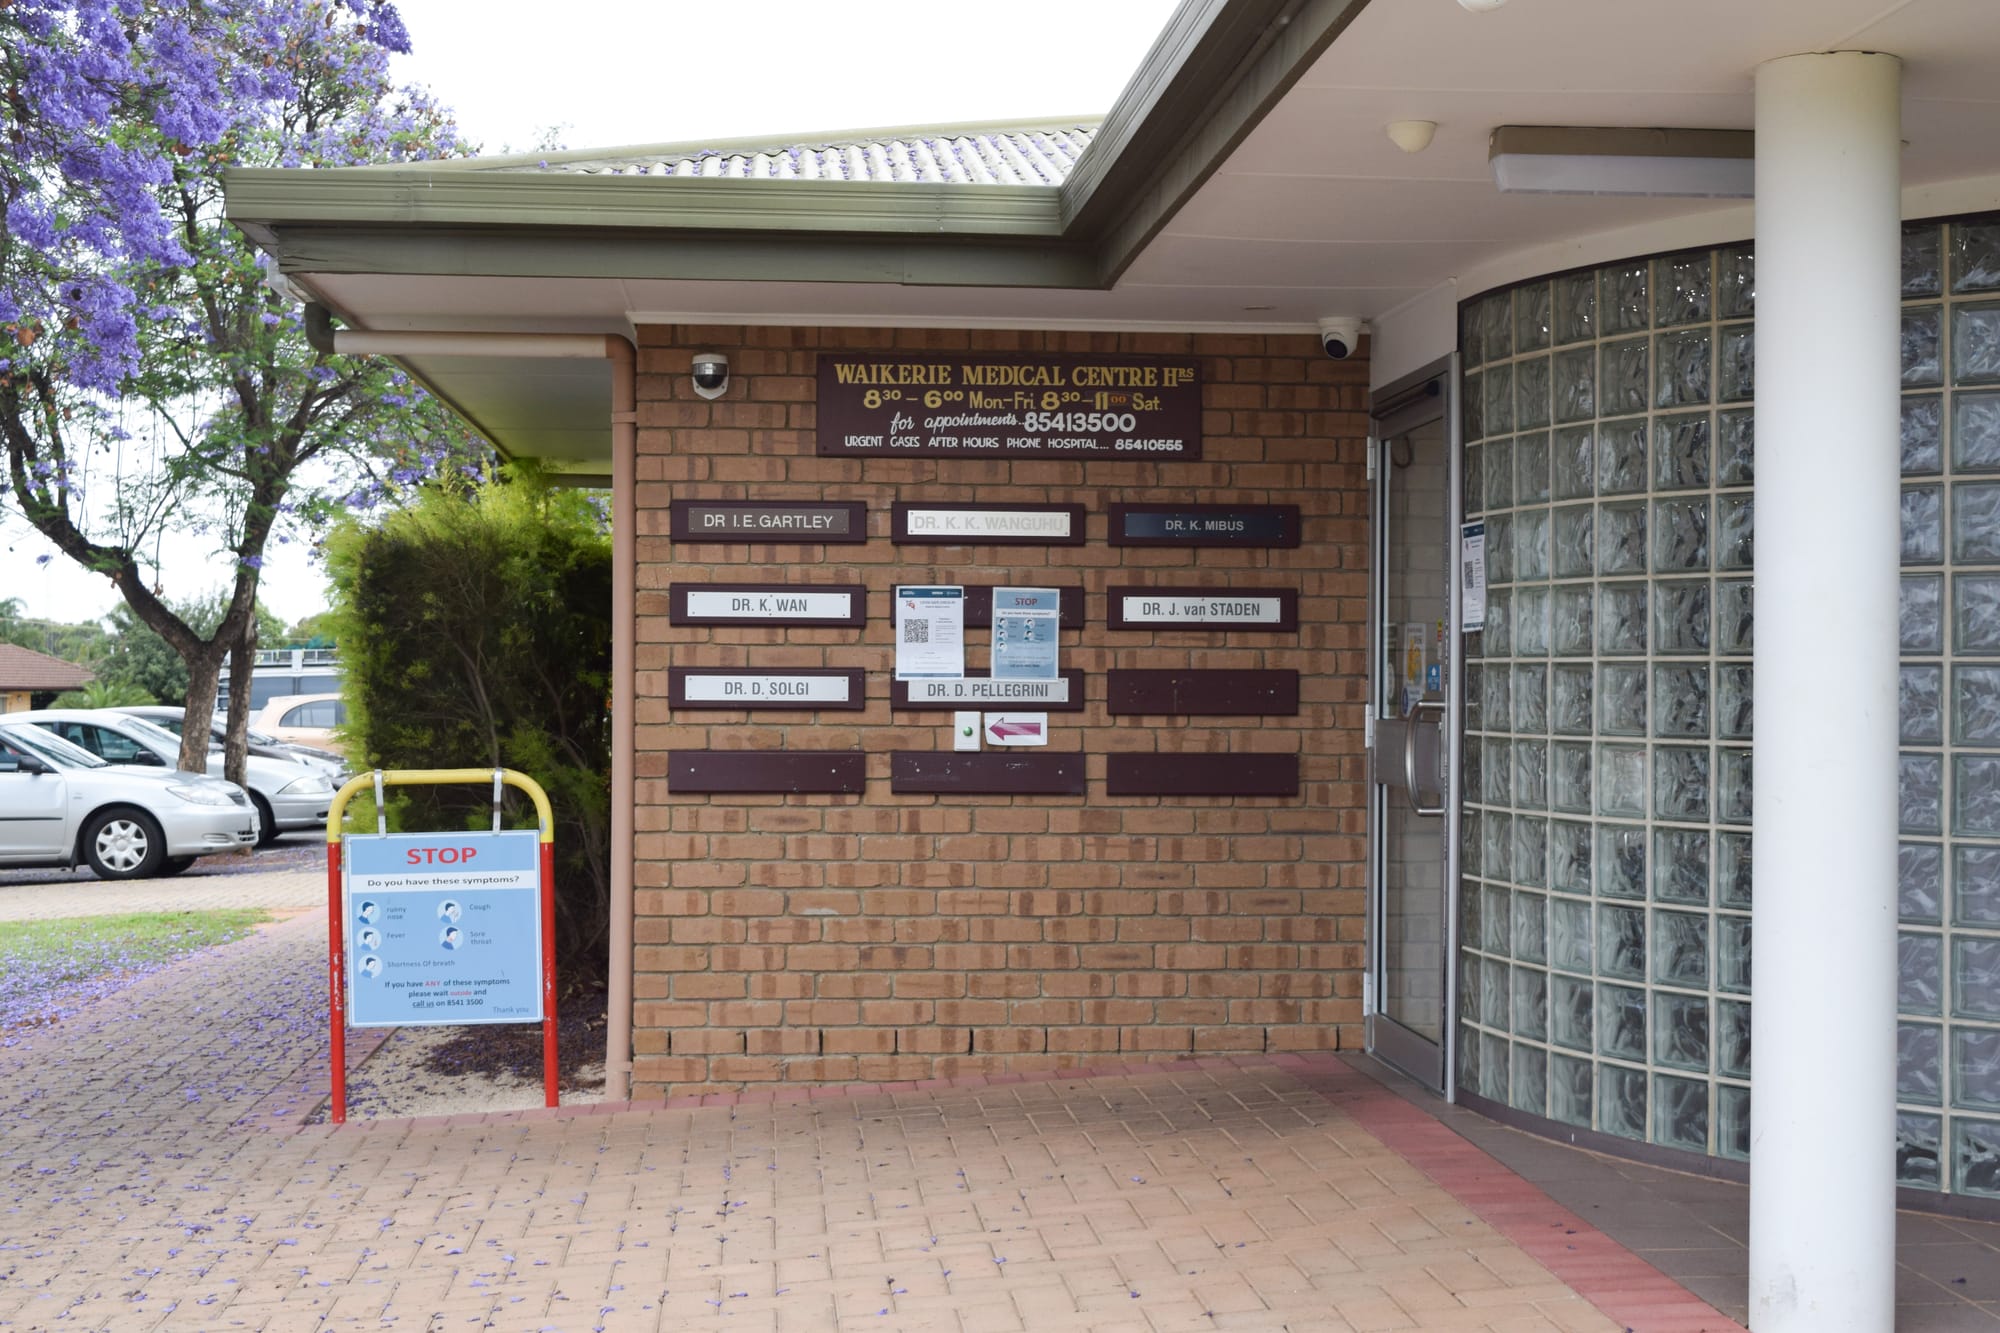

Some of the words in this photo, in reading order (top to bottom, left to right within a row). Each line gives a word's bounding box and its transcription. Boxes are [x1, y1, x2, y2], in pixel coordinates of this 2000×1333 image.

[834, 364, 952, 384] WAIKERIE
[961, 365, 1066, 386] MEDICAL
[1072, 366, 1158, 387] CENTRE
[890, 411, 915, 435] for
[1024, 412, 1136, 432] 85413500
[844, 435, 884, 447] URGENT
[889, 436, 921, 448] CASES
[928, 436, 958, 448] AFTER
[962, 437, 1000, 448] HOURS
[1006, 437, 1041, 449] PHONE
[703, 513, 726, 527] DR
[759, 515, 833, 529] GARTLEY
[914, 516, 940, 529] DR.
[946, 517, 961, 529] K.
[965, 517, 980, 530] K.
[1165, 520, 1186, 530] DR.
[1189, 520, 1203, 531] K.
[1205, 520, 1244, 531] MIBUS
[732, 598, 755, 611] DR.
[759, 599, 772, 611] K.
[776, 599, 808, 612] WAN
[1015, 597, 1038, 606] STOP
[1142, 602, 1164, 616] DR.
[1169, 603, 1180, 616] J.
[1184, 605, 1206, 616] van
[1210, 602, 1261, 616] STADEN
[724, 682, 747, 695] DR.
[752, 682, 765, 695] D.
[769, 682, 809, 695] SOLGI
[927, 684, 950, 697] DR.
[954, 684, 967, 697] D.
[972, 684, 1049, 697] PELLEGRINI
[406, 847, 477, 865] STOP
[367, 879, 382, 887] Do
[384, 880, 403, 888] you
[405, 878, 430, 886] have
[432, 877, 460, 885] these
[462, 875, 520, 885] symptoms?
[469, 903, 492, 911] Cough
[432, 959, 455, 967] breath
[406, 980, 423, 988] have
[473, 978, 510, 986] symptoms
[408, 990, 432, 998] please
[412, 1000, 425, 1008] call
